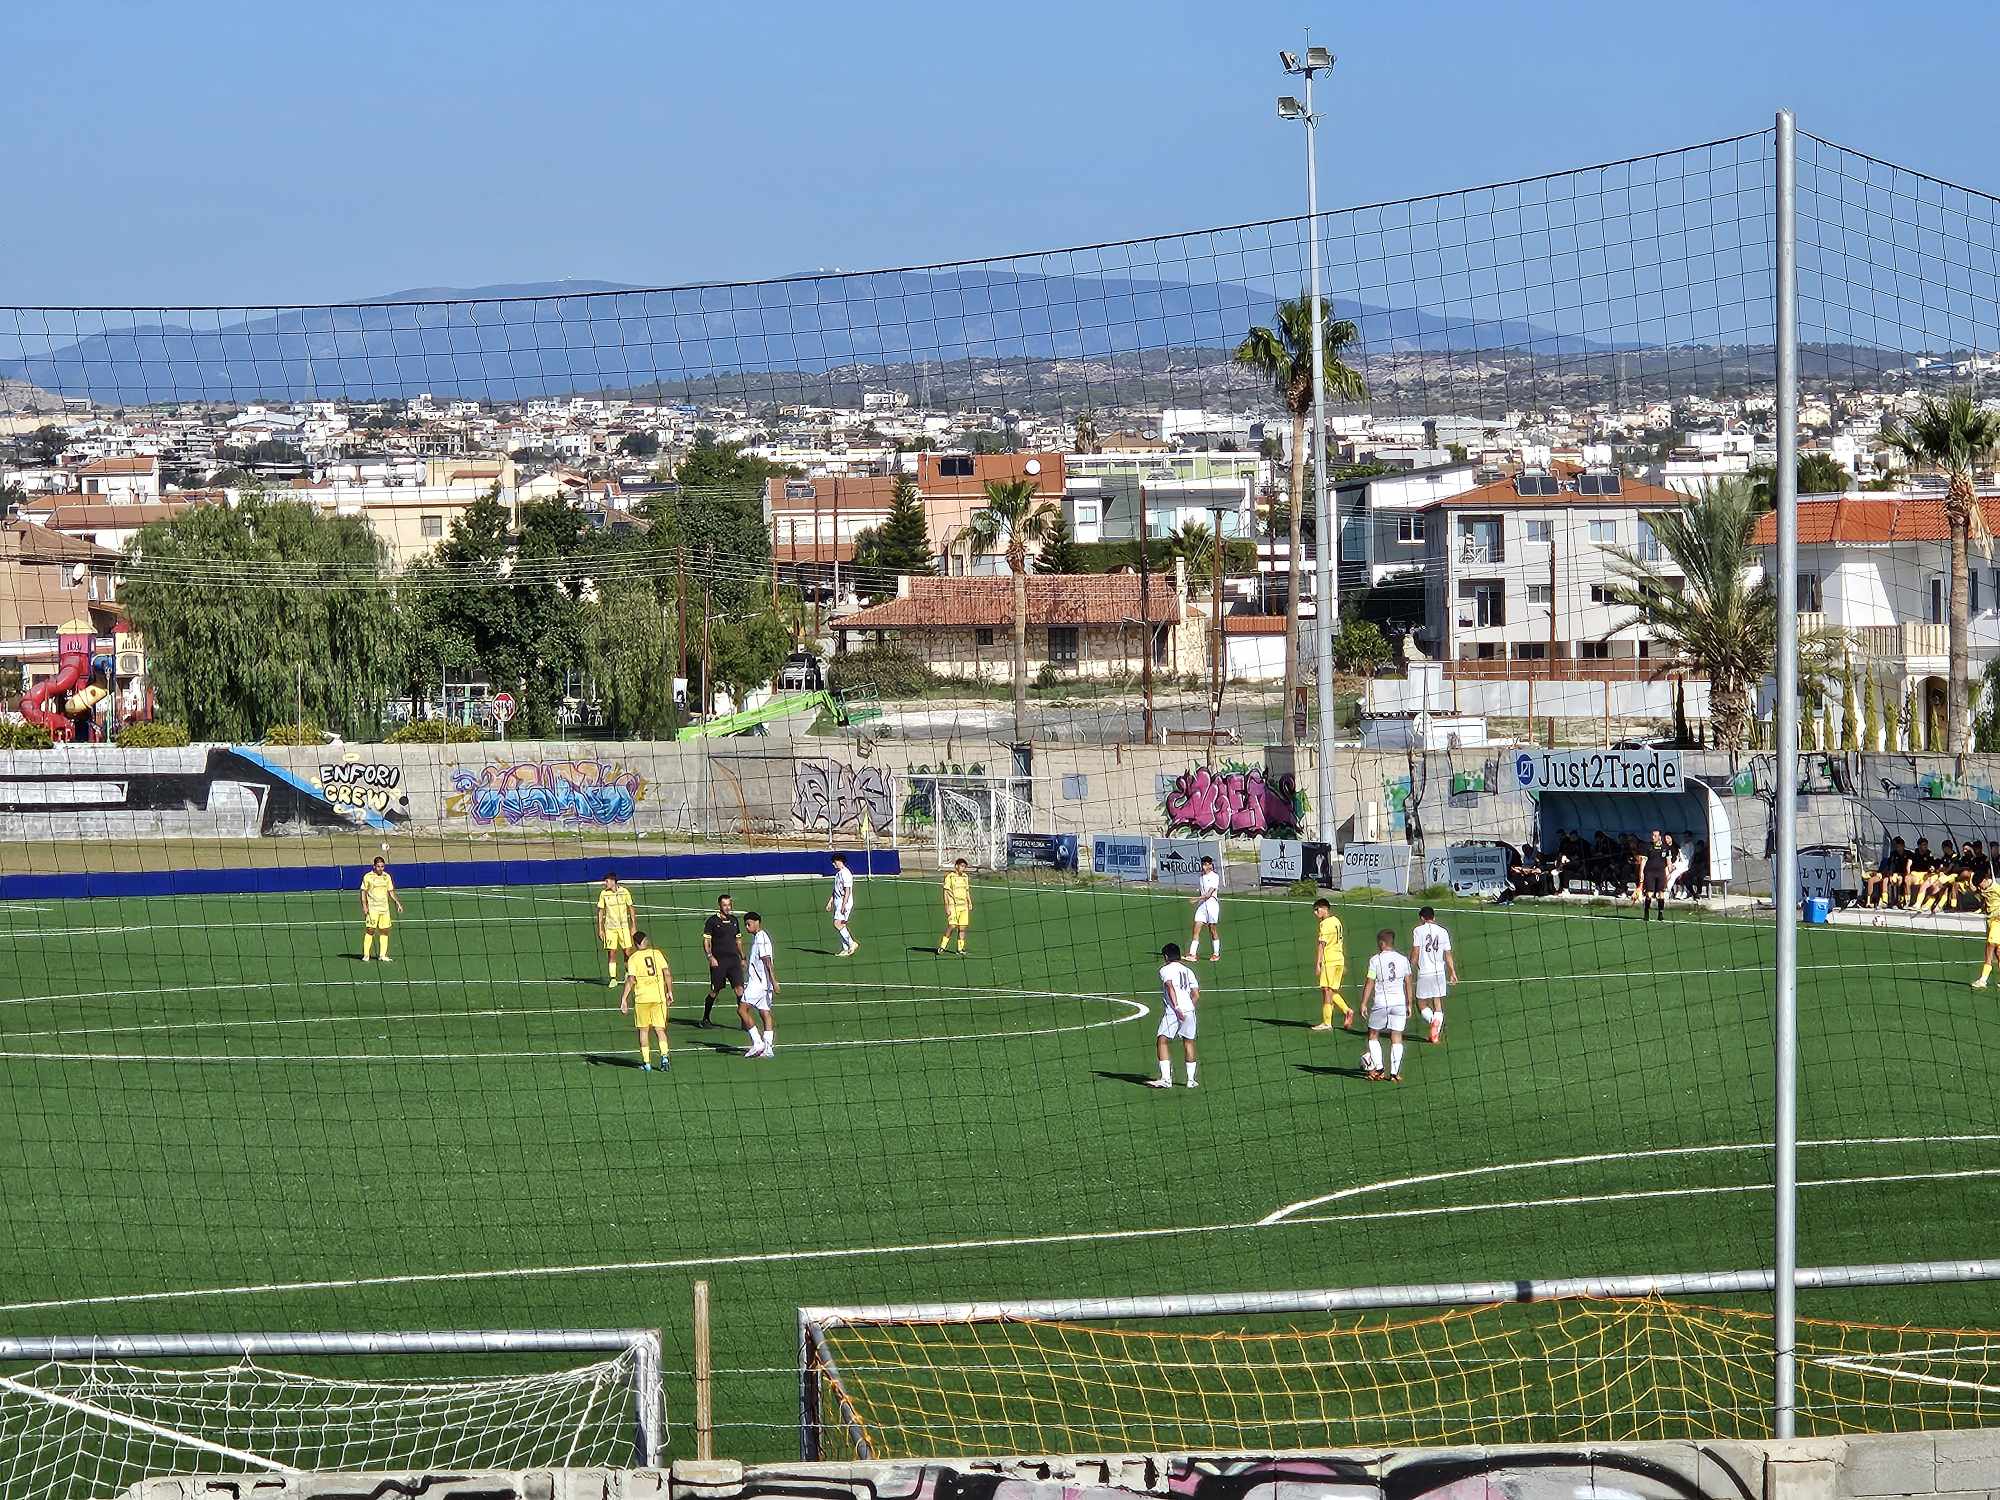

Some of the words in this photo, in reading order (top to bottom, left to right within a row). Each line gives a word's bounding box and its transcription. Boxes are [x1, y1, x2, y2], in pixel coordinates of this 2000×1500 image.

[1538, 752, 1675, 788] Just2Trade
[323, 784, 389, 811] CREW
[1270, 860, 1295, 871] CASTLE
[1346, 853, 1379, 866] COFFEE
[1425, 933, 1439, 952] 24
[644, 956, 656, 976] 9
[1388, 961, 1396, 982] 3
